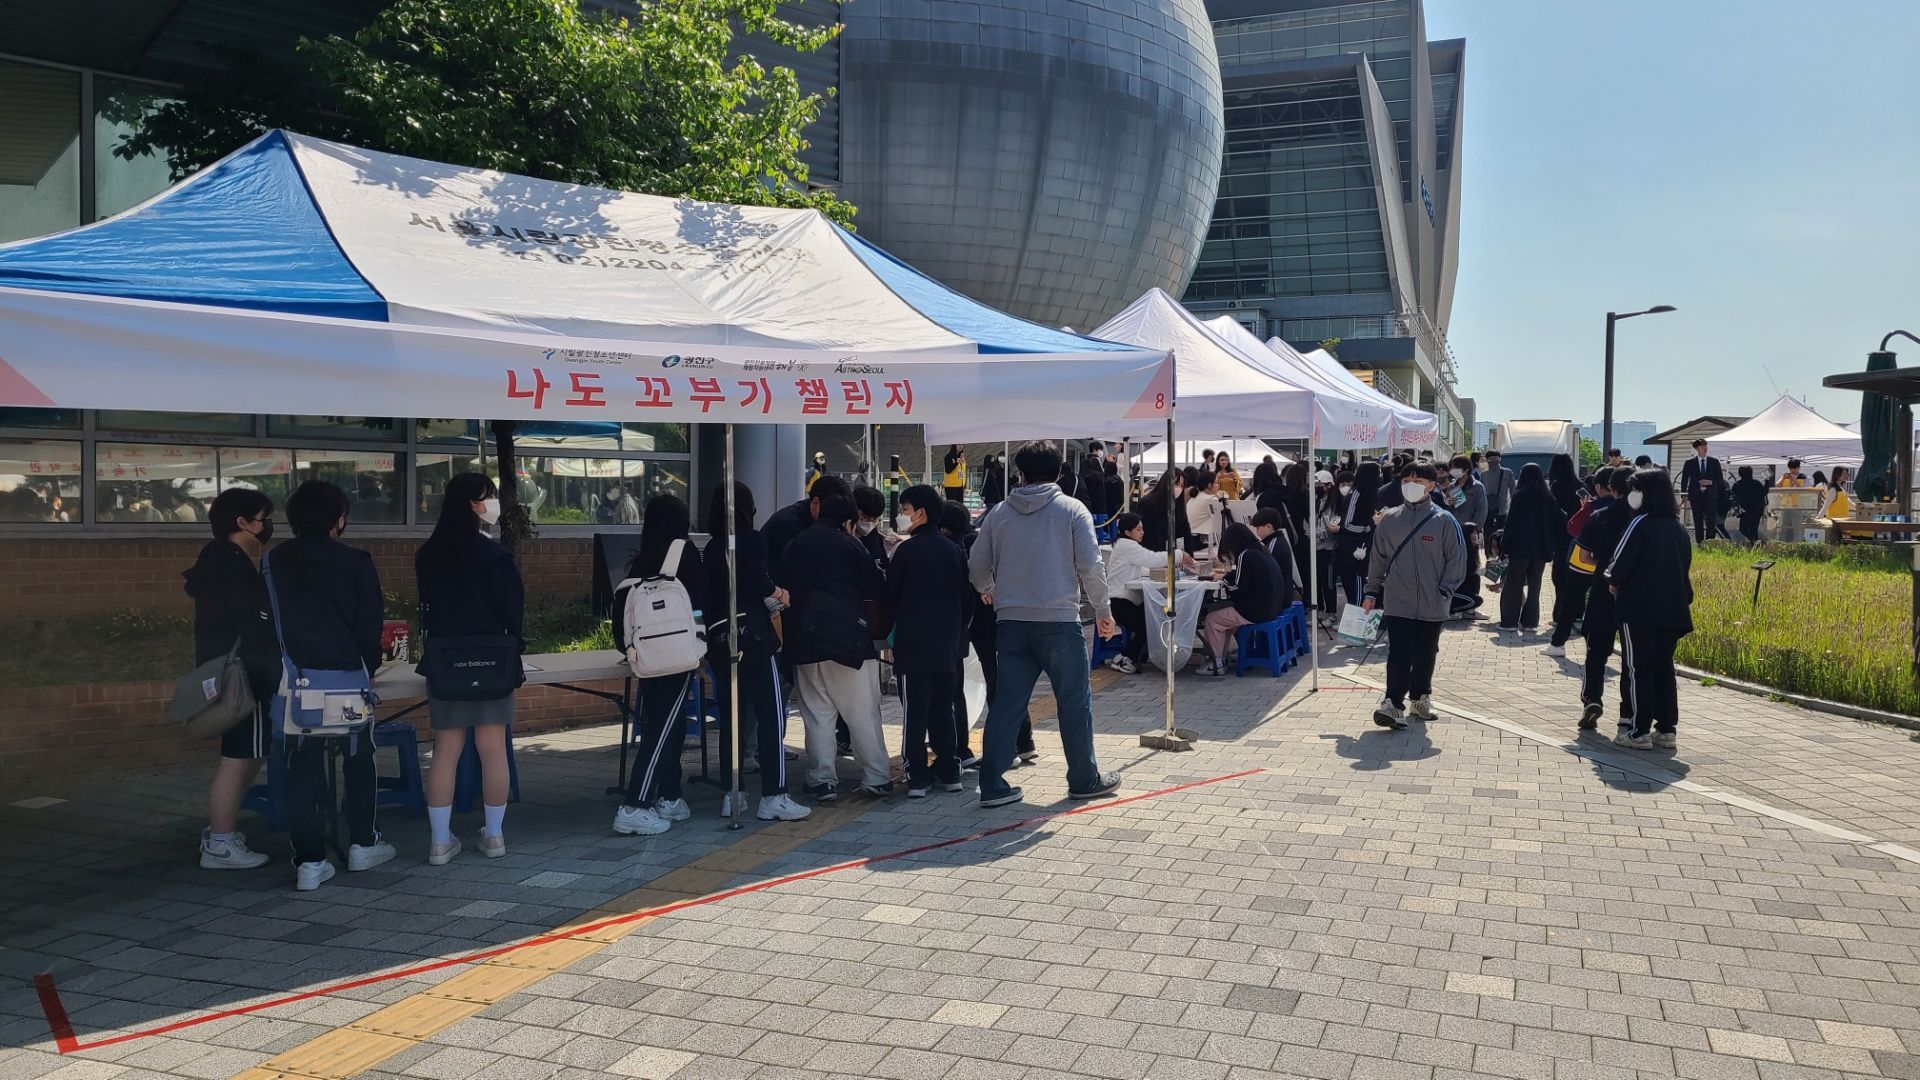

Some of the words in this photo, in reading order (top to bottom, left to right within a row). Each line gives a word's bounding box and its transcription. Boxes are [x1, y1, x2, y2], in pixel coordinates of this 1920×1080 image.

[683, 356, 715, 364] 광진구
[506, 368, 607, 410] 나도
[634, 376, 773, 414] 꼬부기
[794, 377, 913, 415] 챌린지
[1155, 392, 1165, 410] 8
[468, 659, 496, 667] balance
